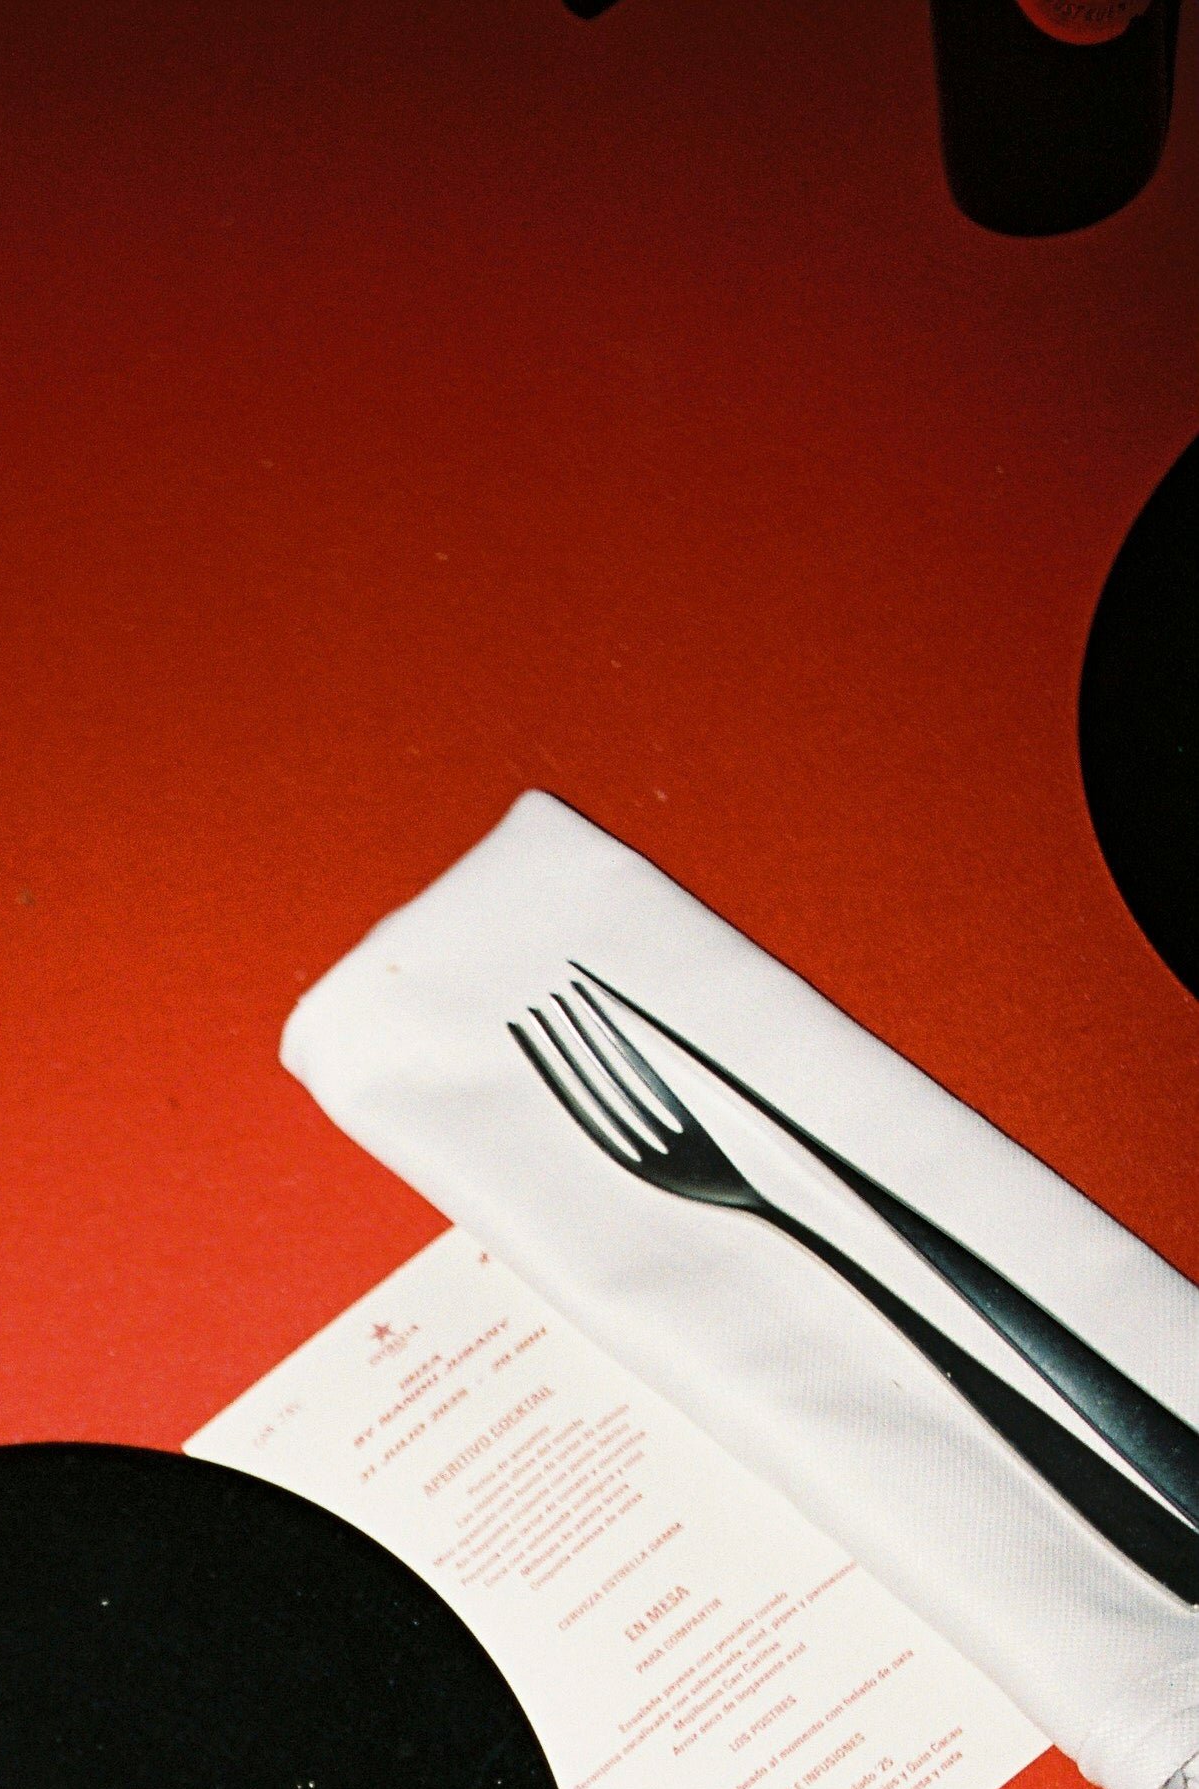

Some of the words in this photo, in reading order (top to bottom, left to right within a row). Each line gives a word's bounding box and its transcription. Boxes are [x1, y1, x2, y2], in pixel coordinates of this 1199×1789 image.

[600, 1549, 649, 1593] ESTRELLA
[644, 1585, 690, 1623] MESA
[635, 1647, 665, 1674] PARA
[662, 1597, 722, 1650] COMPARTIR
[728, 1731, 751, 1753] LOS
[749, 1694, 797, 1735] POSTRES
[824, 1703, 844, 1722] con
[801, 1731, 865, 1785] INFUSIONES
